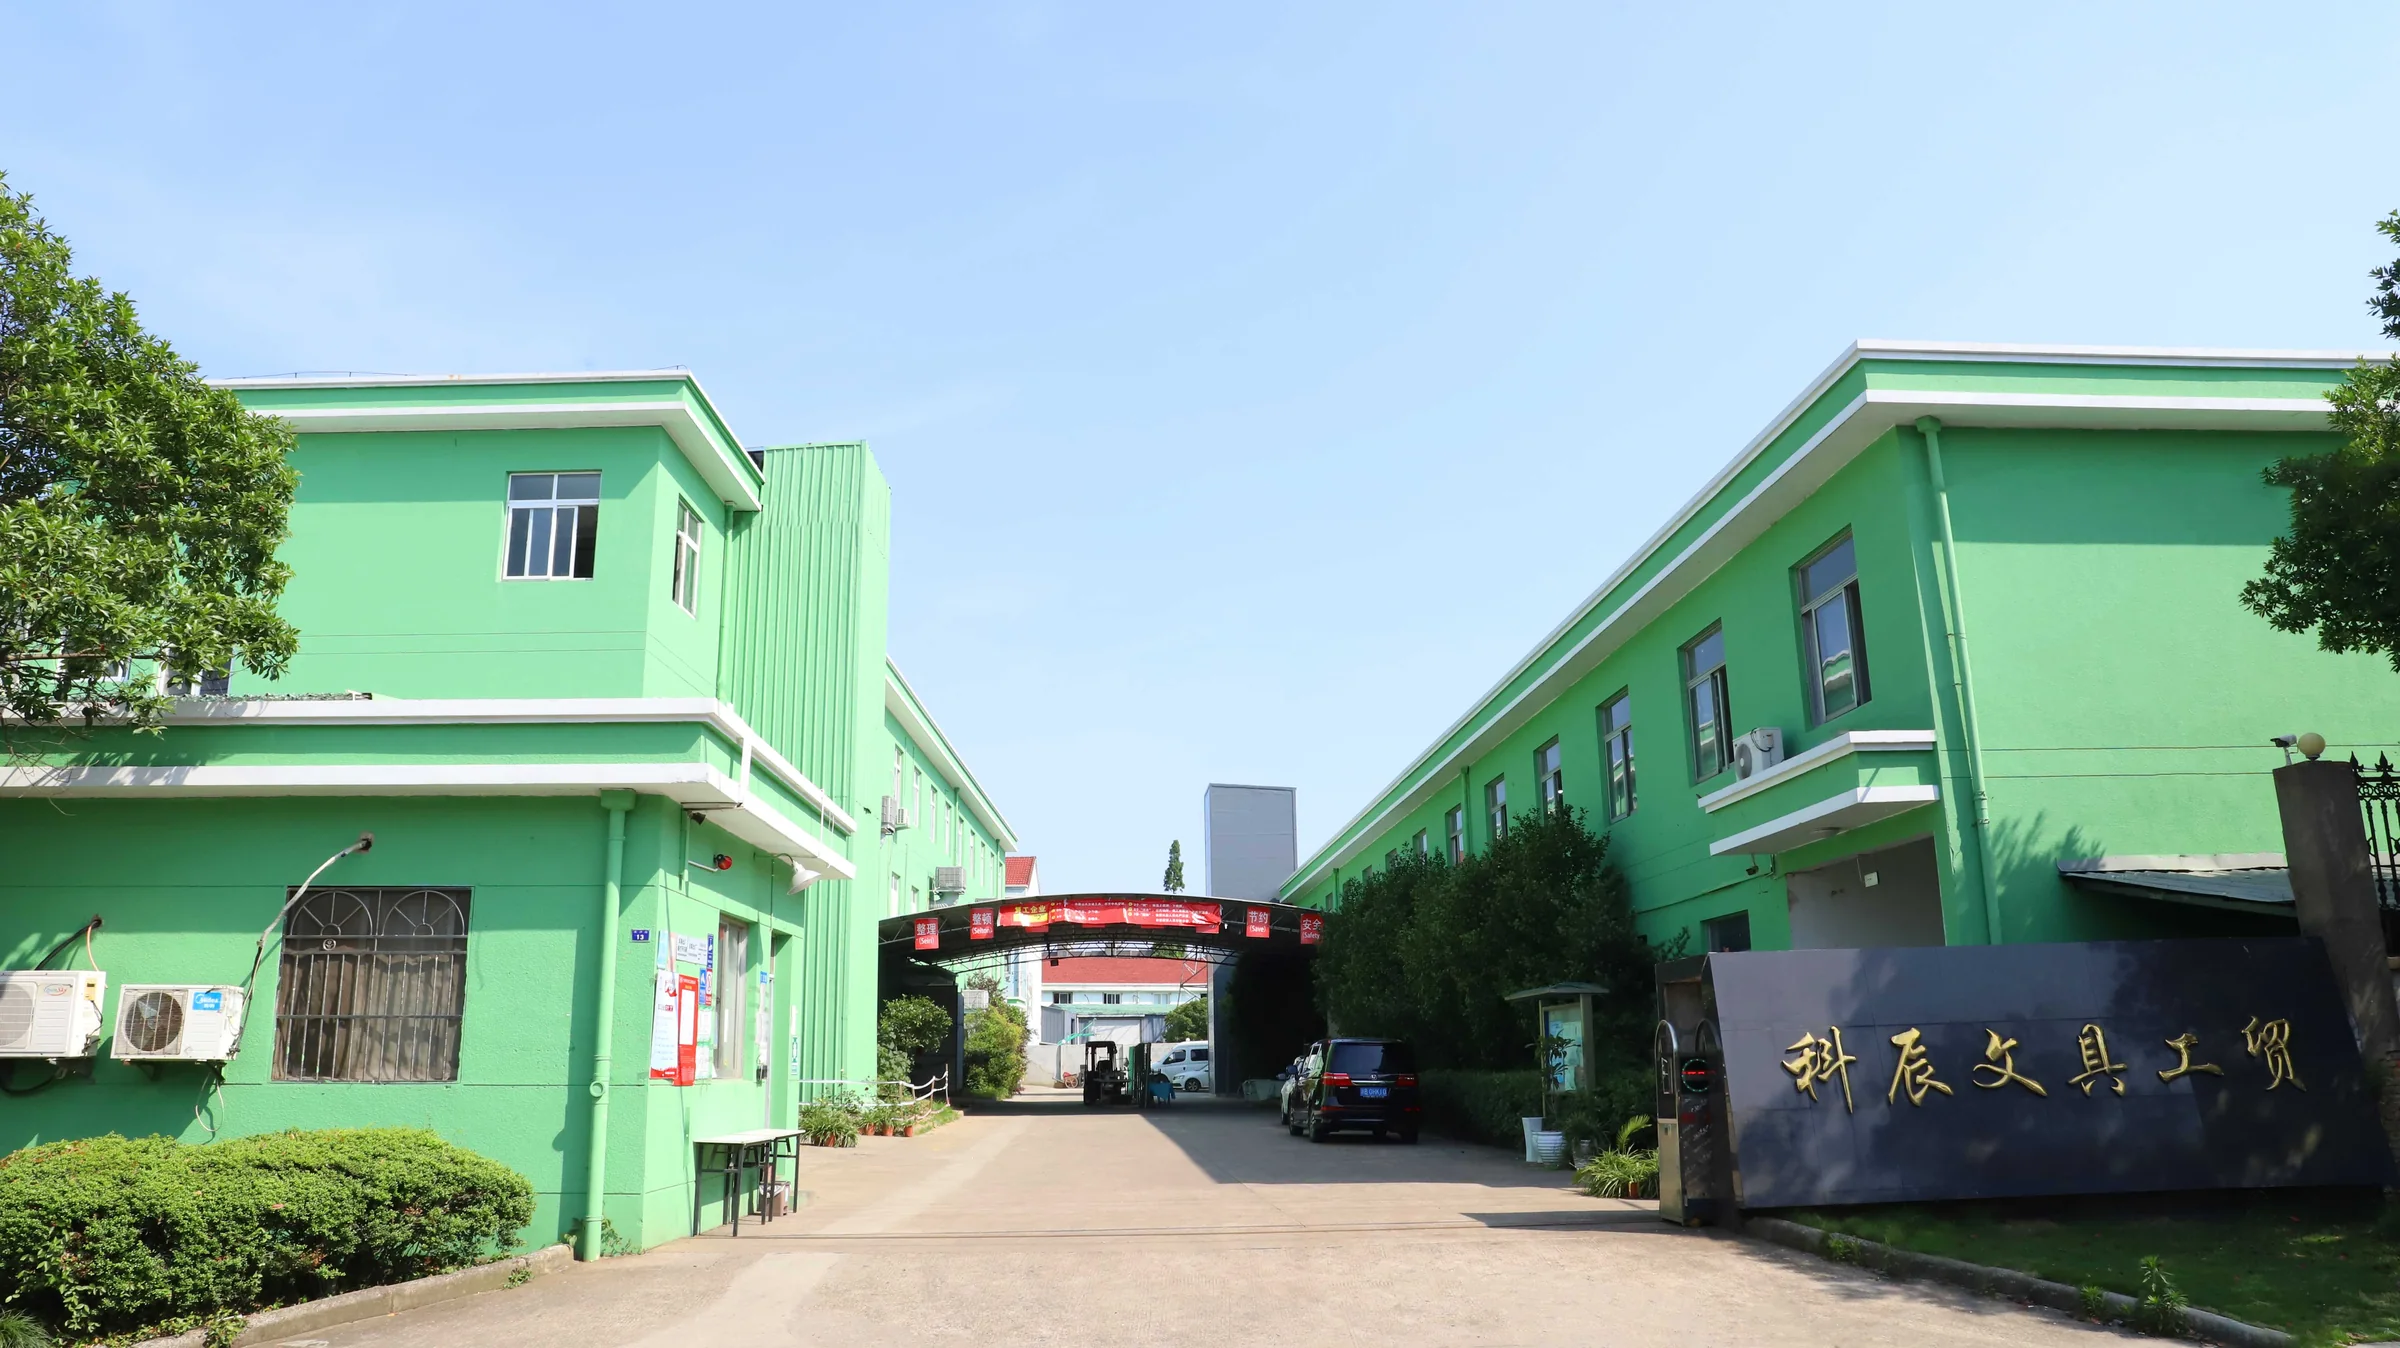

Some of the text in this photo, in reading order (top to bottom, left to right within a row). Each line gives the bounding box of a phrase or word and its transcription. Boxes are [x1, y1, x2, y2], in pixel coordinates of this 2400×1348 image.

[1248, 911, 1269, 924] 节约
[916, 923, 937, 936] 整理
[1249, 925, 1266, 933] (Save)
[1302, 918, 1322, 931] 安全
[1303, 931, 1320, 940] (Safety
[1780, 1015, 2307, 1114] 科辰文具工贸
